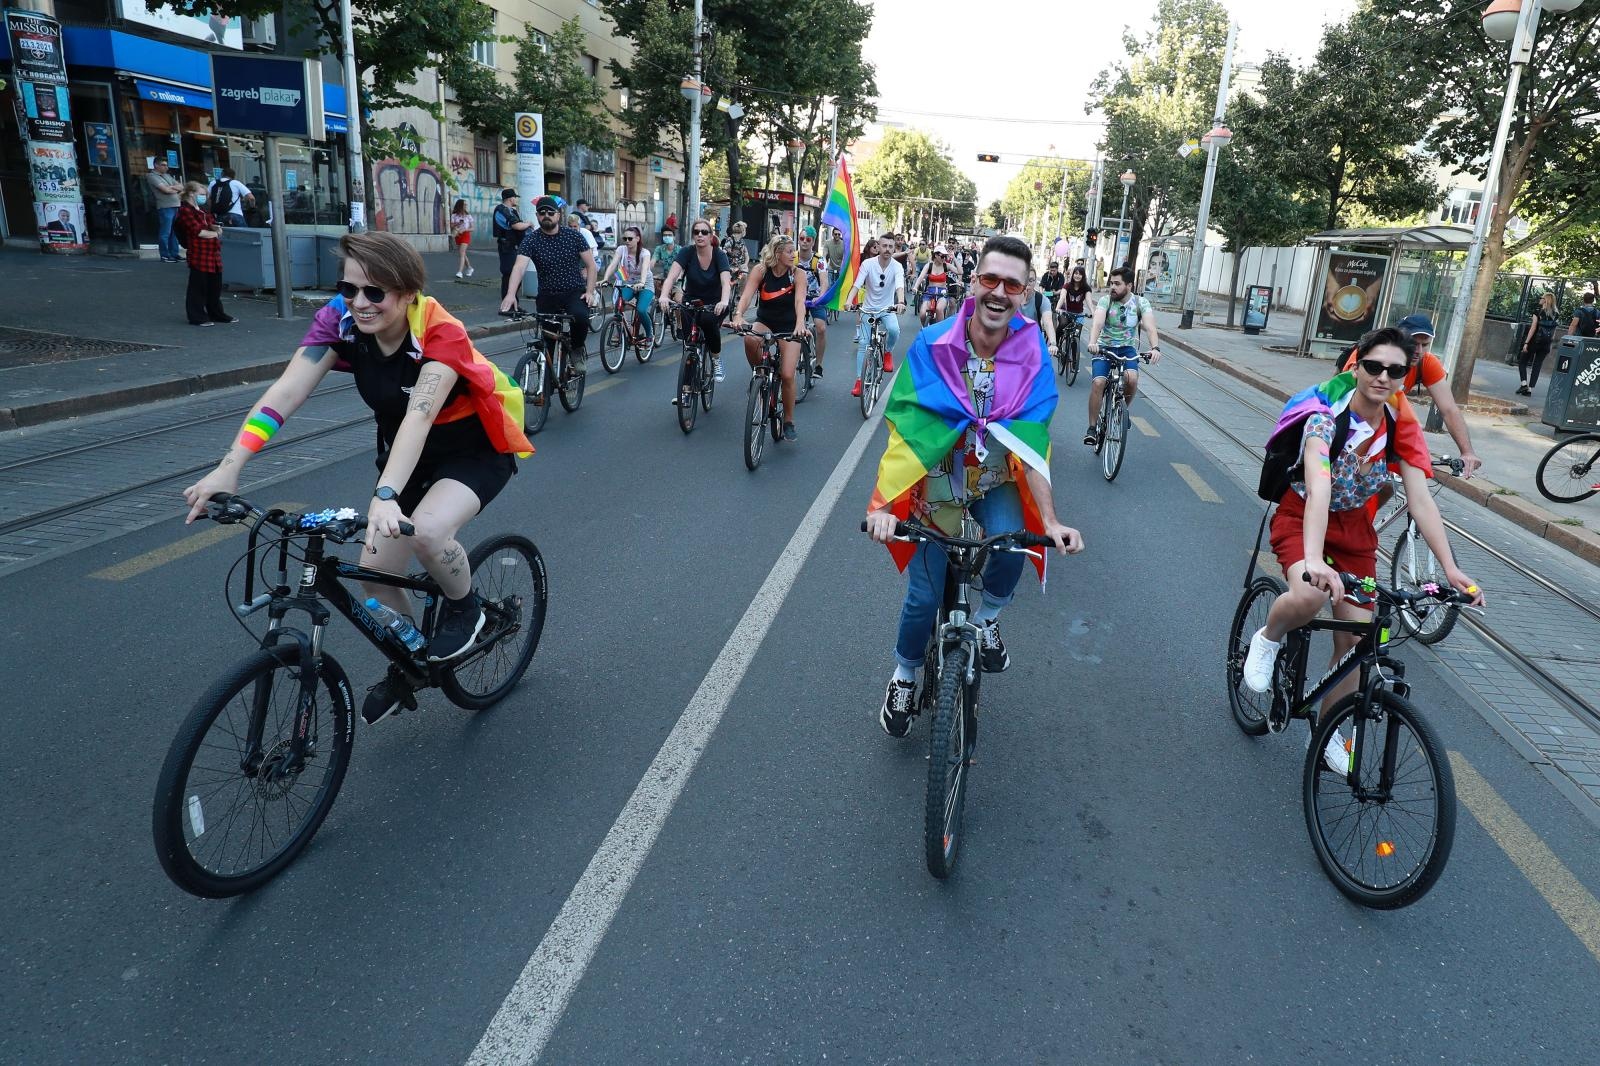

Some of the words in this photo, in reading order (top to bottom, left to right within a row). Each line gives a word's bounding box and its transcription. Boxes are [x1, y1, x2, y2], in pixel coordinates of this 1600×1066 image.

[10, 21, 58, 36] MISSION
[158, 90, 186, 103] mlinar
[221, 87, 260, 100] zagreb
[264, 89, 295, 103] plakat
[35, 119, 66, 127] CUBISMO
[522, 120, 532, 133] S
